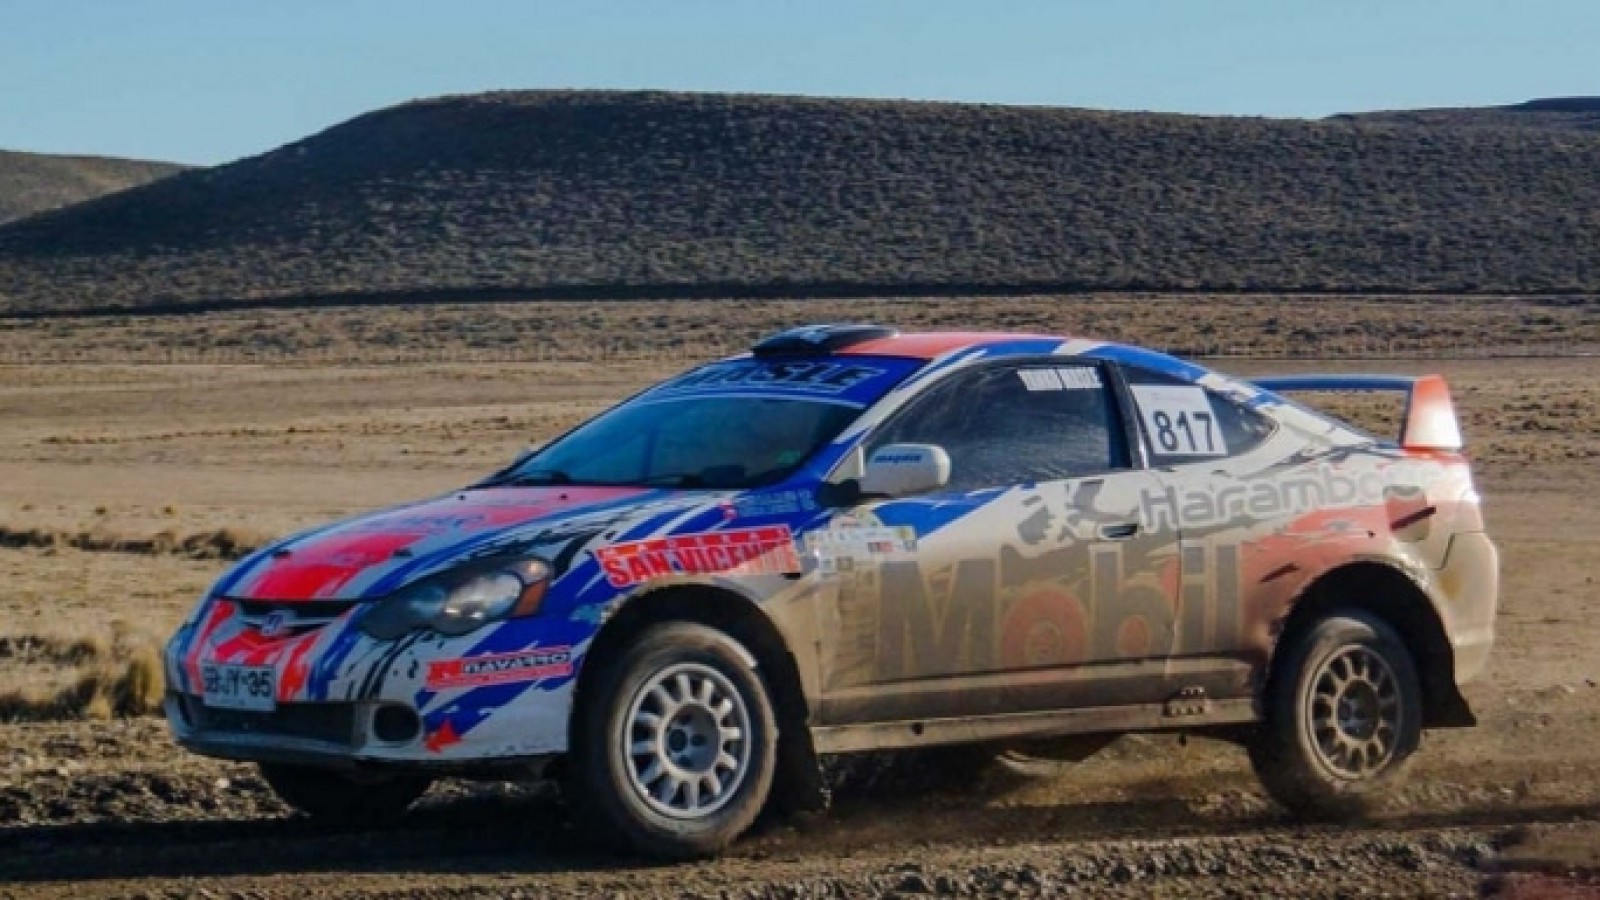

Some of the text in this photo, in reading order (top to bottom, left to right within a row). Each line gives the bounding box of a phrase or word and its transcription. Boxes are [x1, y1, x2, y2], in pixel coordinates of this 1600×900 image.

[1153, 410, 1215, 452] 817
[603, 549, 672, 588] SAN
[875, 545, 1241, 677] Mobil
